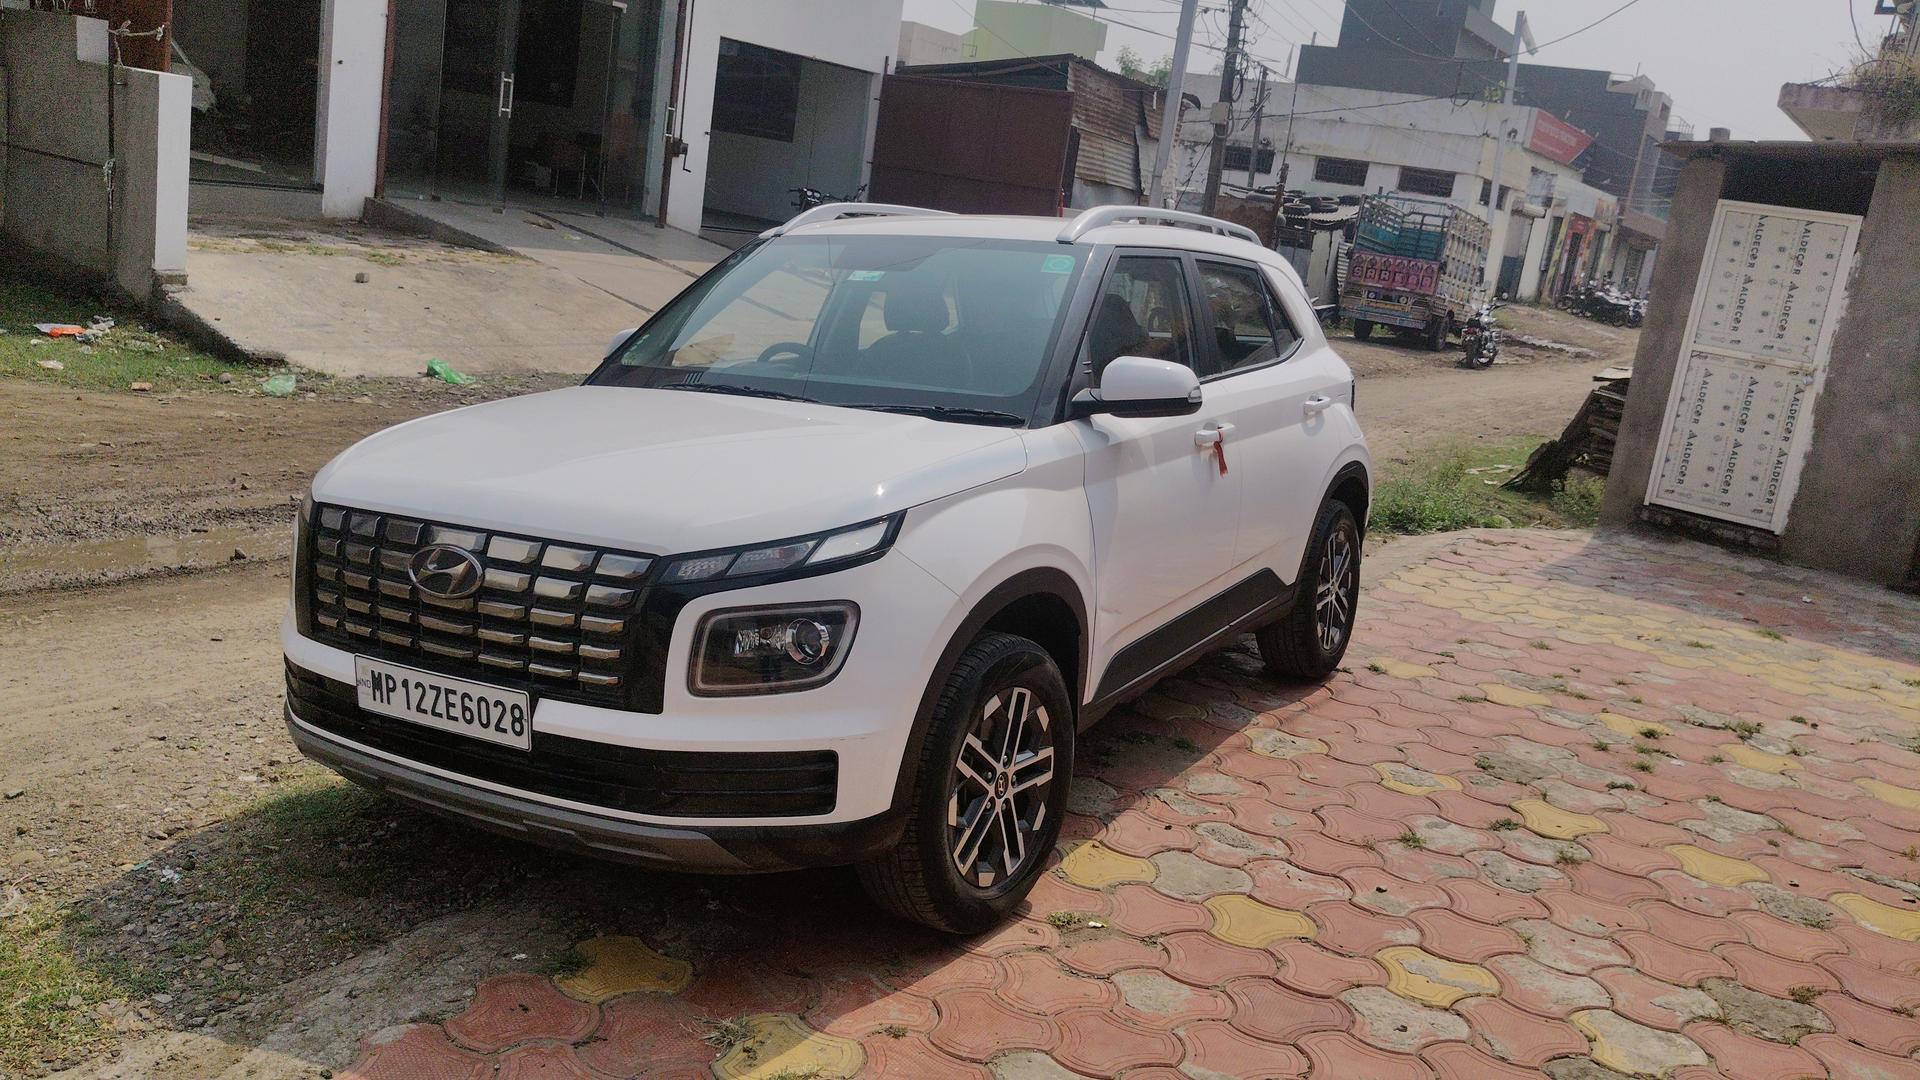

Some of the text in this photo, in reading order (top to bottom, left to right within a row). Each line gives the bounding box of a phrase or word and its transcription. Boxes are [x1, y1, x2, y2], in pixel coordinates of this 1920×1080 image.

[1747, 221, 1765, 269] ALDECOR
[1792, 228, 1811, 275] ALDECOR
[1731, 286, 1749, 332] ALDECOR
[1776, 293, 1794, 339] ALDECOR
[1692, 380, 1708, 424] ALDECOR
[1737, 388, 1754, 433] ALDECOR
[1782, 396, 1800, 442] ALDECOR
[1676, 441, 1693, 485] ALDECOR
[1721, 450, 1738, 494] ALDECOR
[1765, 459, 1783, 504] ALDECOR
[371, 669, 525, 737] MP12ZE6028
